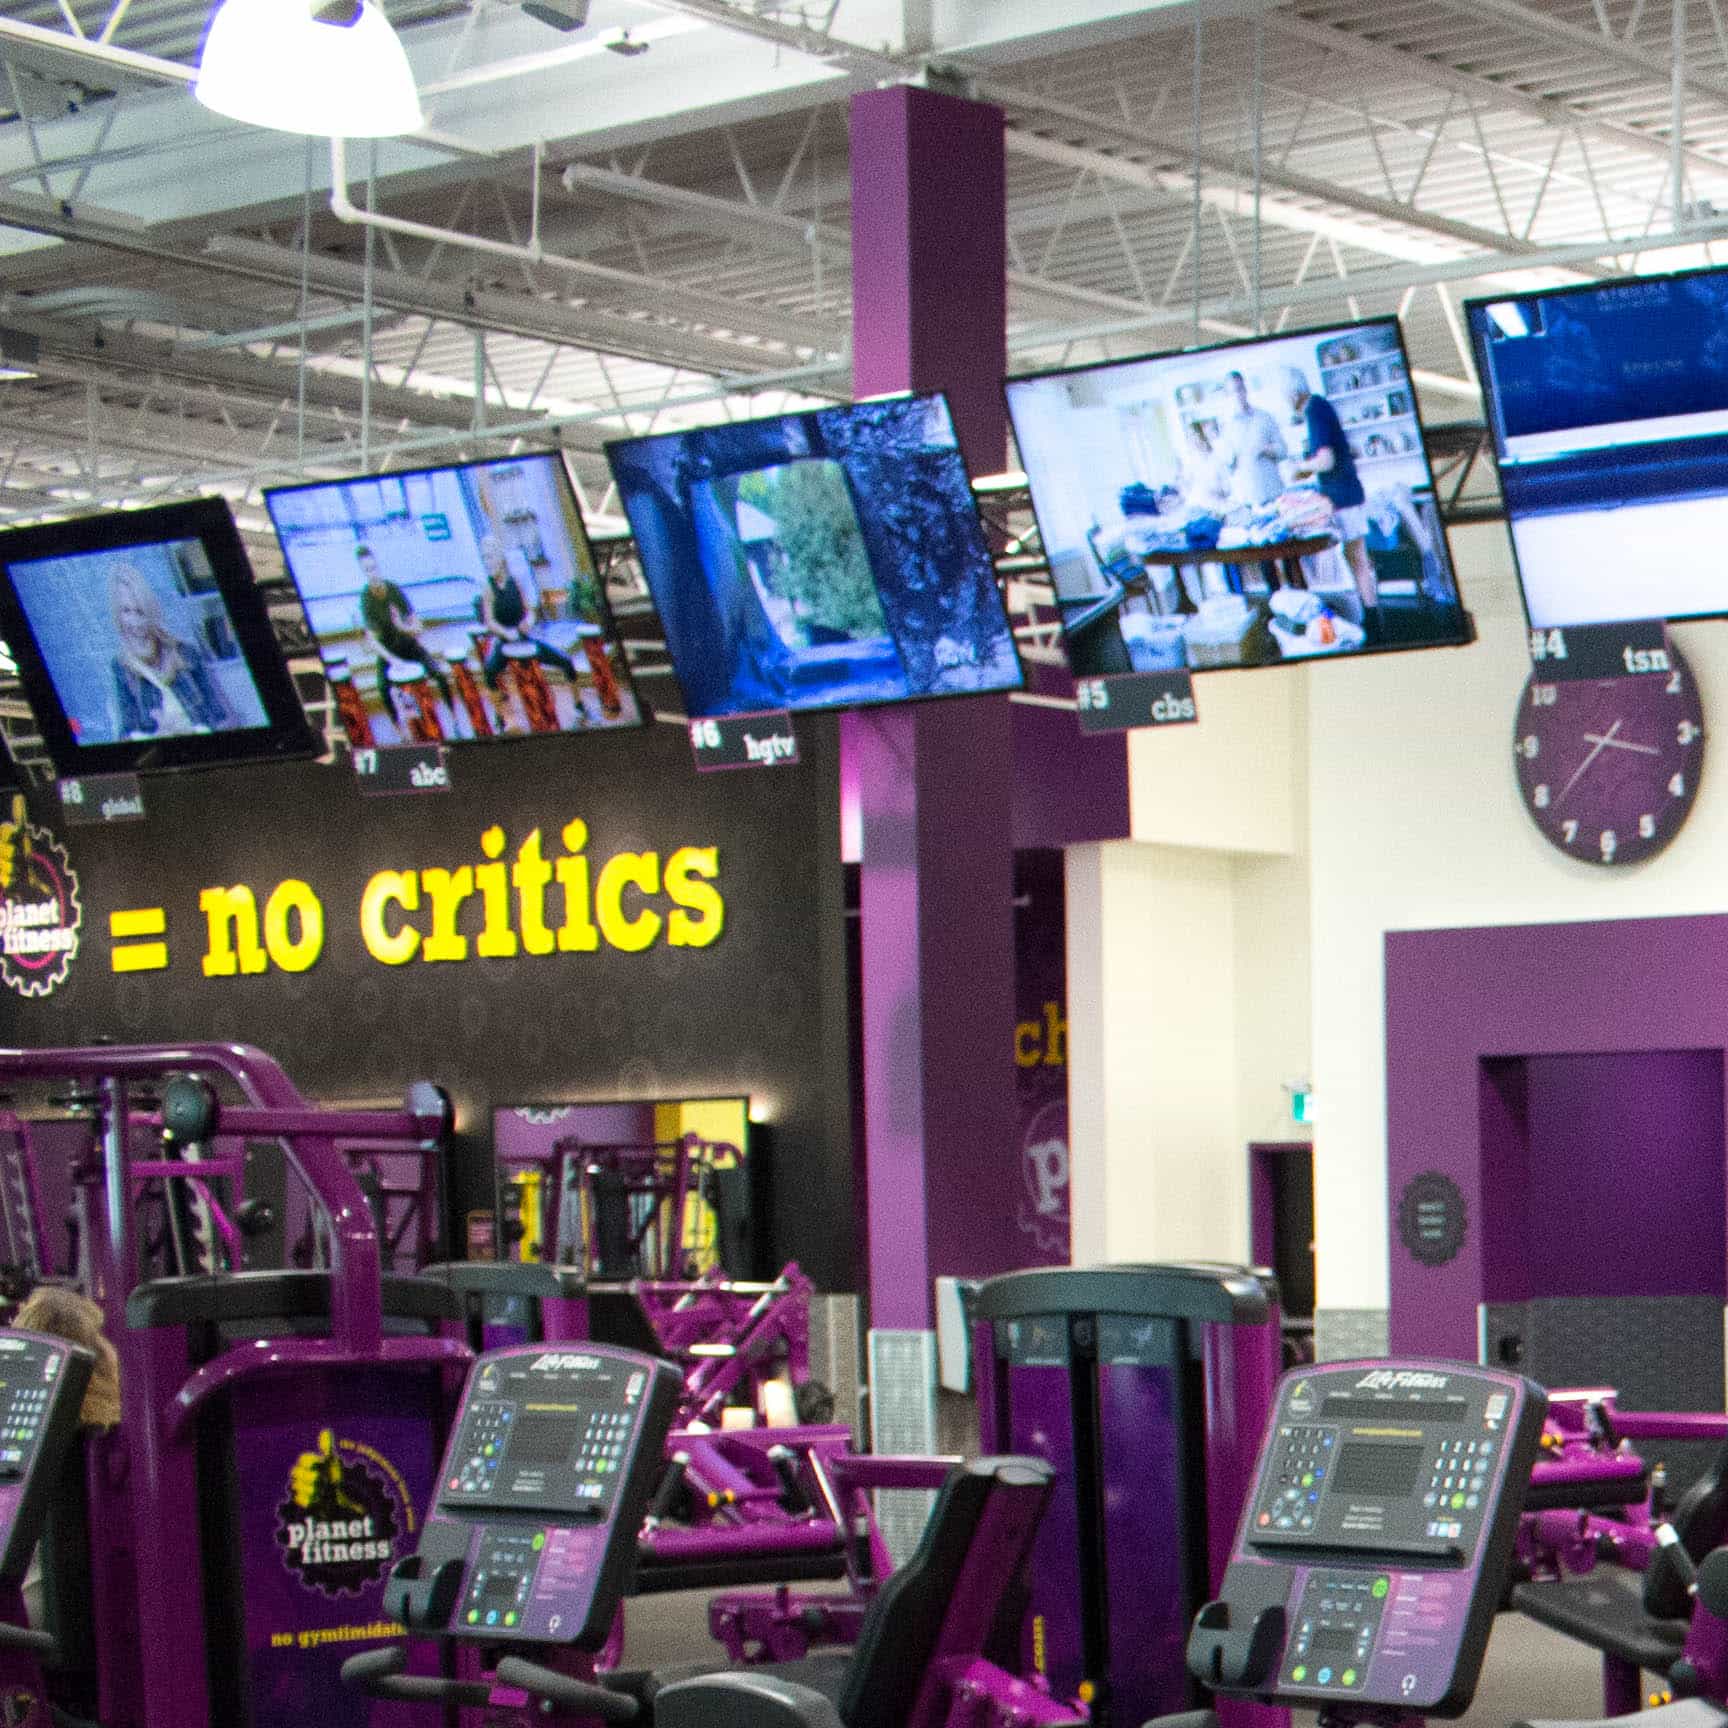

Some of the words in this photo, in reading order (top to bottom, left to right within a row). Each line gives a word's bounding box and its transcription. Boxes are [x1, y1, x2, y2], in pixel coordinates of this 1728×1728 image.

[1532, 628, 1568, 660] #4
[1623, 646, 1670, 674] tsn
[1078, 680, 1110, 711] #5
[1152, 692, 1196, 721] cbs
[689, 720, 722, 749] #6
[743, 733, 796, 765] hgtv
[410, 761, 448, 786] abc
[200, 878, 324, 977] no
[360, 818, 725, 965] critics
[288, 1515, 374, 1549] planet
[301, 1539, 391, 1564] fitness
[271, 1632, 294, 1647] no
